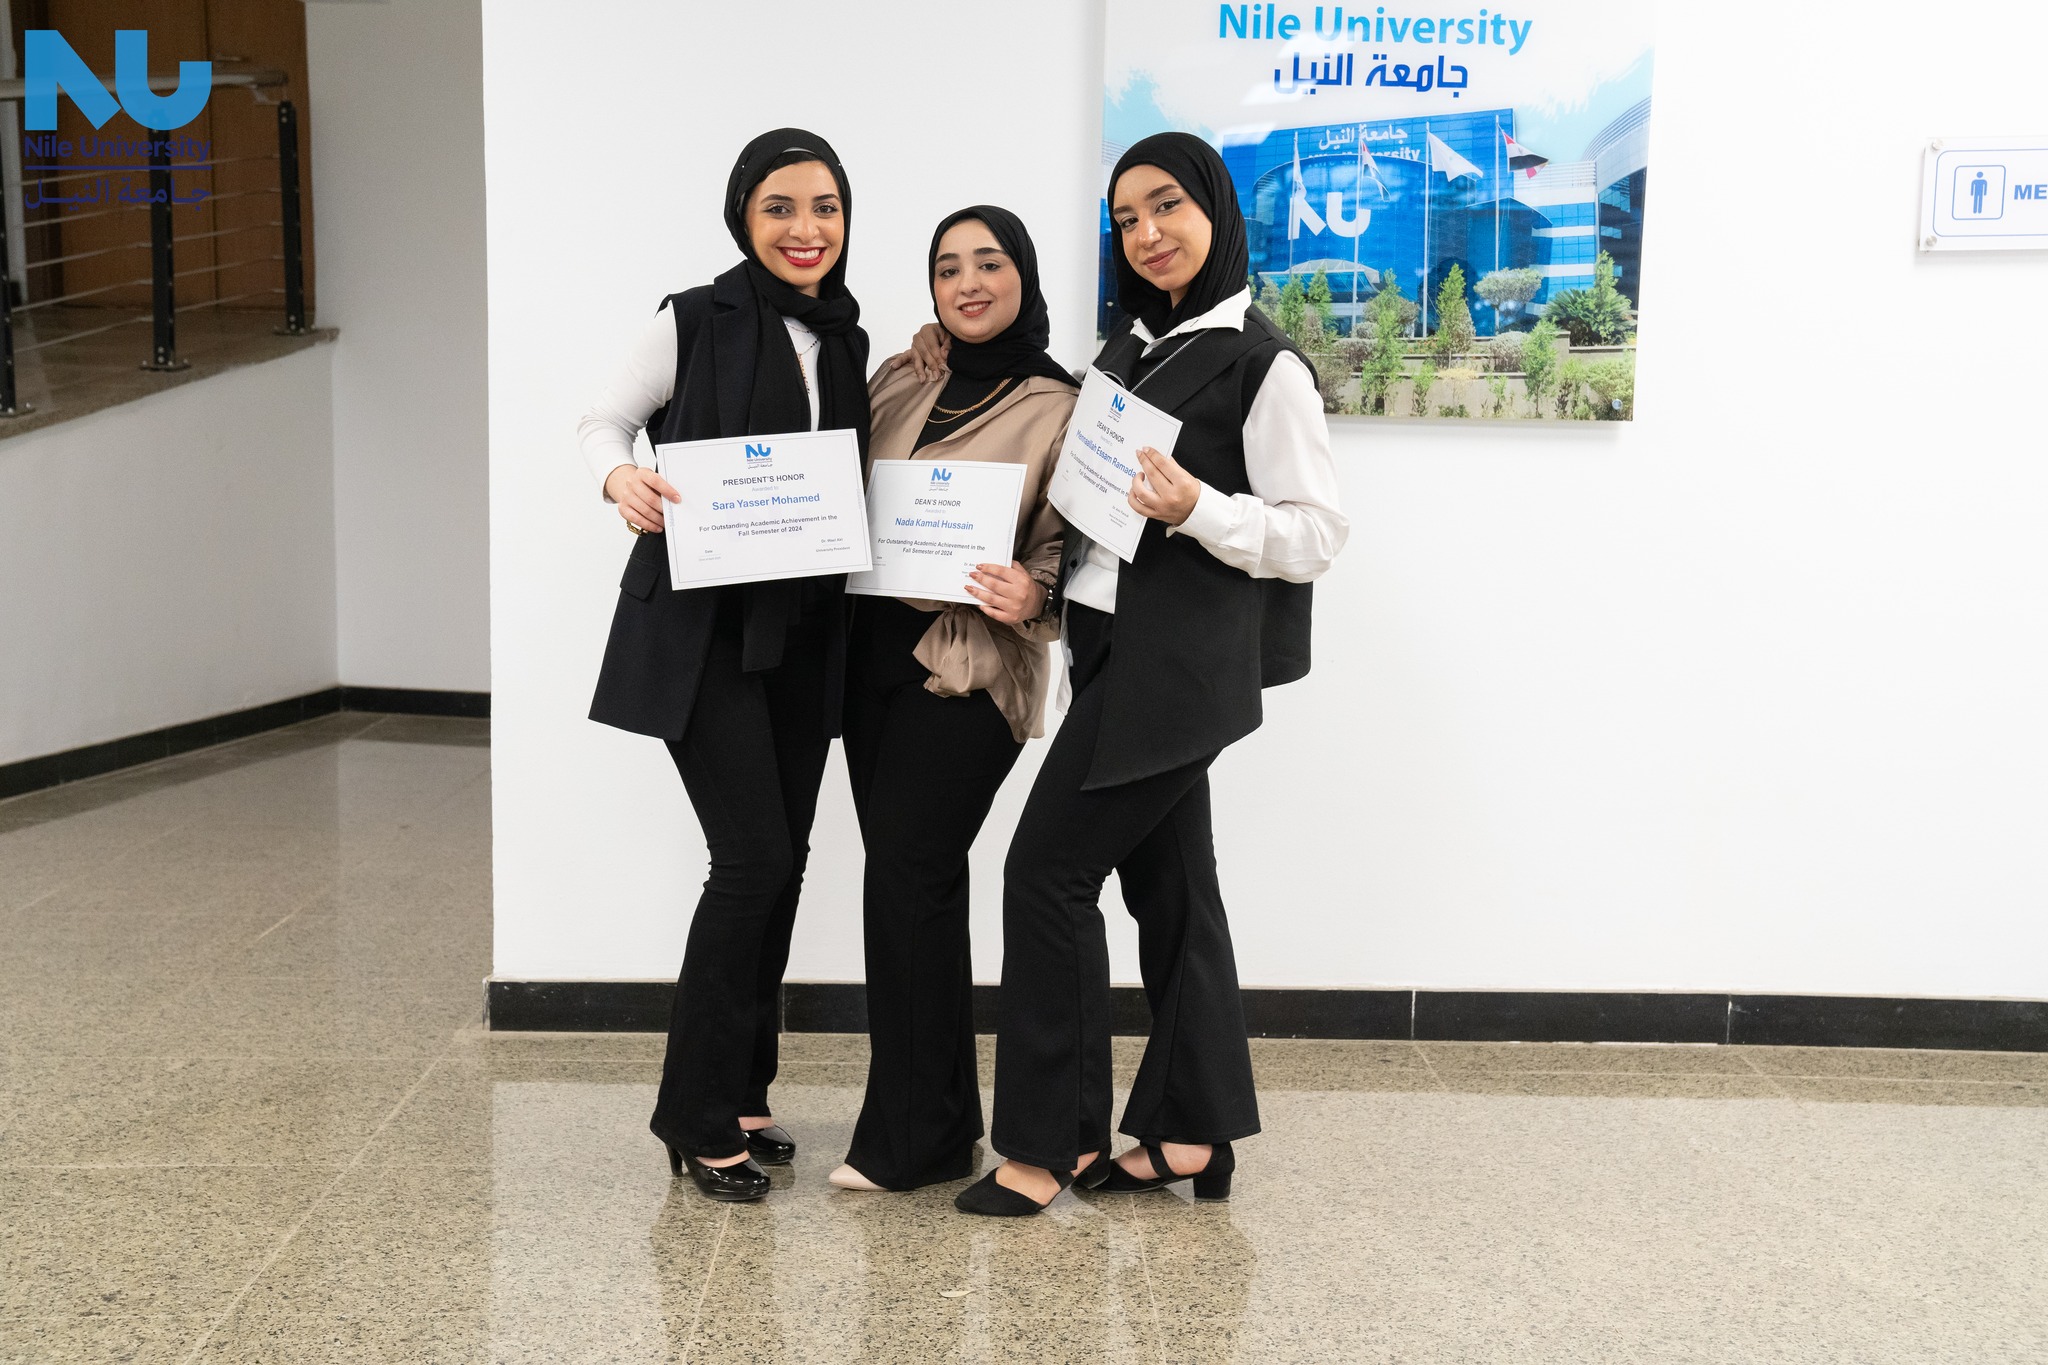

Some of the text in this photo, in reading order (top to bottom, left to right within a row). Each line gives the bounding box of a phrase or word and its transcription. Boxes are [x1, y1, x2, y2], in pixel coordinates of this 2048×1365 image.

[1219, 3, 1533, 56] Nile University
[1274, 52, 1469, 98] جامعة النيل
[1318, 123, 1408, 150] جامعة النيل
[2014, 184, 2048, 200] ME
[1111, 393, 1126, 412] NU
[1109, 430, 1125, 444] HONOR
[745, 443, 771, 458] NU
[931, 468, 952, 481] NU
[1112, 457, 1137, 478] Ramada
[722, 473, 805, 486] PRESIDENT'S HONOR
[712, 493, 820, 511] Sara Yasser Mohamed
[711, 522, 749, 531] Outstanding
[750, 519, 780, 527] Academic
[780, 515, 820, 524] Achievement
[751, 528, 780, 536] Semester
[788, 525, 803, 533] 2024
[895, 517, 974, 531] Nada Kamal Hussain
[886, 538, 914, 546] Outstanding
[938, 542, 970, 550] Achievement
